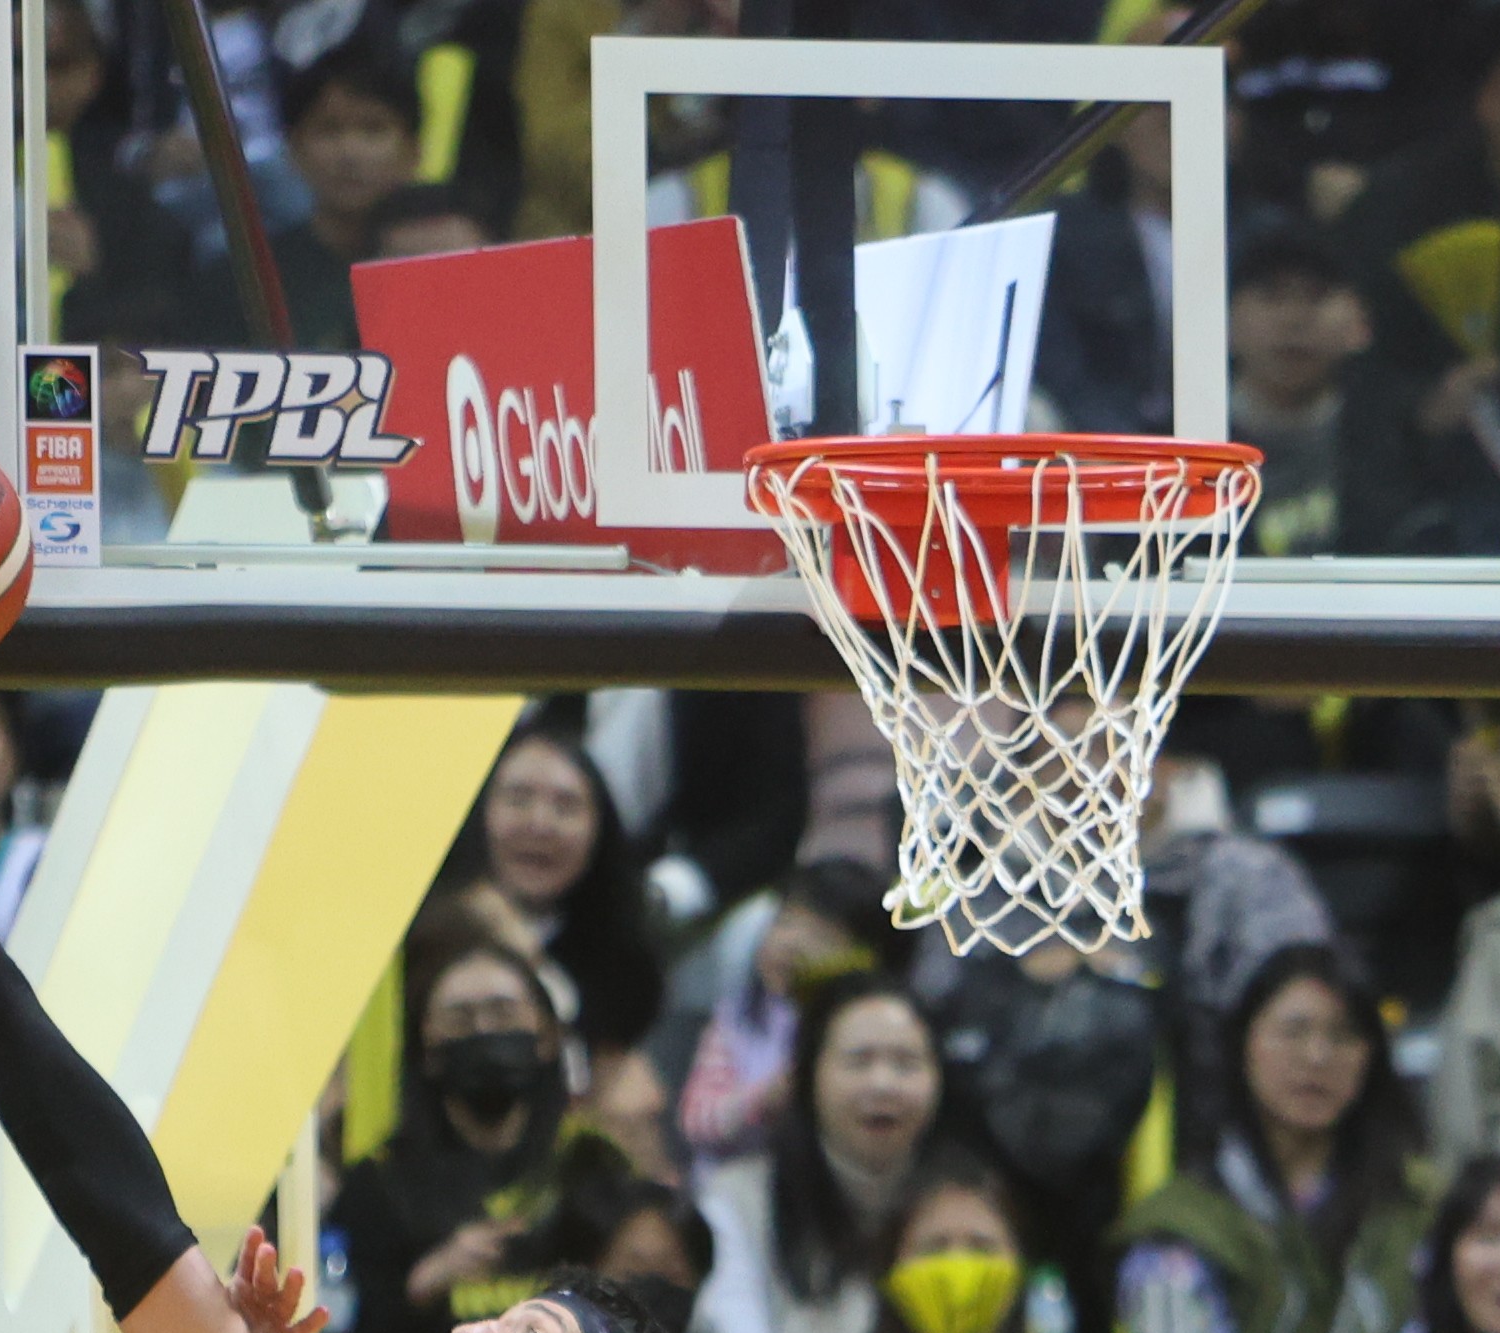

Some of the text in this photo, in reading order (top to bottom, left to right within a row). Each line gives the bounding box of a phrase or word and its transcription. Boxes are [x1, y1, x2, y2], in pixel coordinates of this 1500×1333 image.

[36, 435, 83, 459] FIBA
[138, 351, 422, 465] TPBL
[498, 383, 596, 524] Glob
